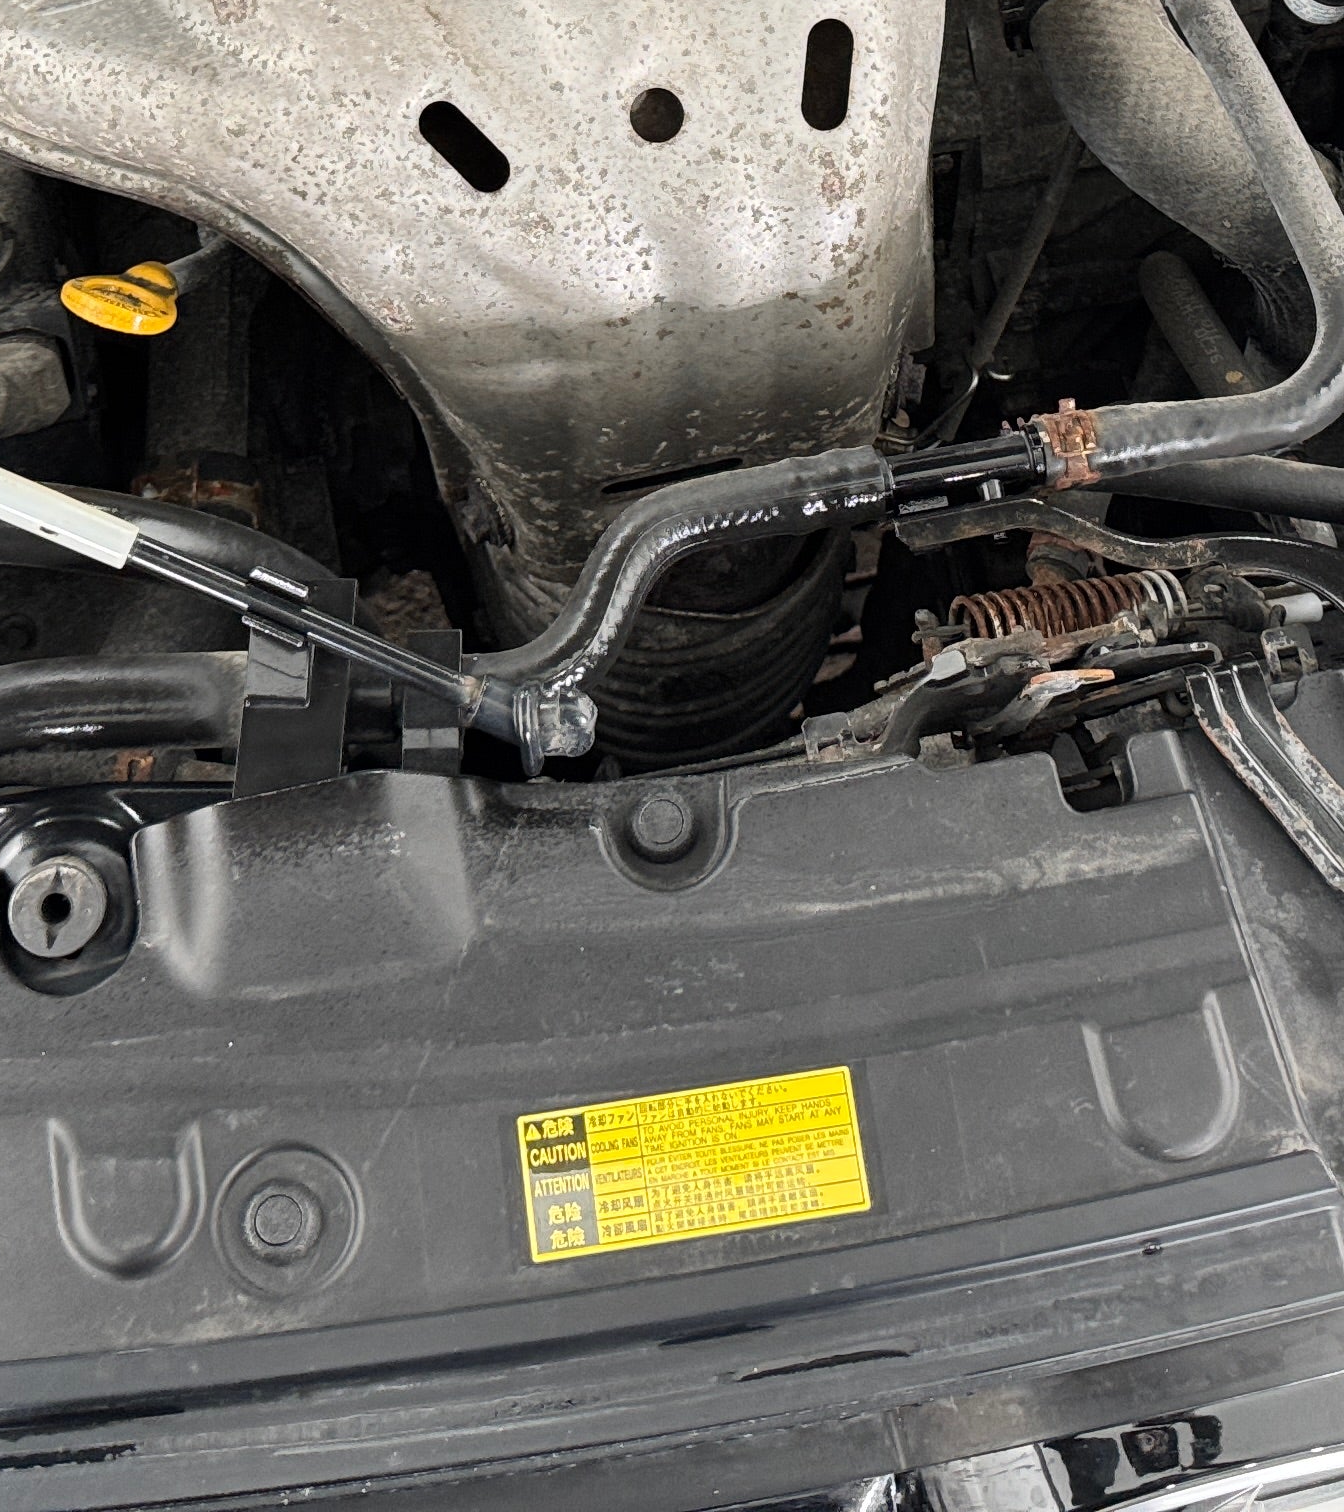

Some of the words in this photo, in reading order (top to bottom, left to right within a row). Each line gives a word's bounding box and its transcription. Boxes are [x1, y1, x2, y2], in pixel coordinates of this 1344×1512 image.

[588, 1109, 635, 1128] 冷却ファン
[642, 1125, 654, 1135] TO
[658, 1121, 684, 1132] AVOID
[688, 1113, 733, 1128] PERSONAL
[774, 1103, 797, 1114] KEEP
[801, 1098, 831, 1110] HANDS
[643, 1133, 667, 1144] AWAY
[671, 1128, 696, 1139] FROM
[729, 1120, 752, 1131] FANS
[756, 1116, 774, 1126] MAY
[778, 1112, 805, 1123] START
[809, 1109, 819, 1118] AT
[823, 1106, 842, 1116] ANY
[541, 1116, 574, 1139] 危険
[529, 1140, 587, 1167] CAUTION
[590, 1139, 619, 1154] COOLING
[621, 1136, 638, 1149] FANS
[644, 1142, 664, 1153] TIME
[669, 1136, 707, 1149] IGNITION
[711, 1134, 720, 1142] IS
[720, 1149, 768, 1164] VENTILATEURS
[533, 1172, 590, 1198] ATTENTION
[595, 1167, 642, 1185] VENTILATEURS
